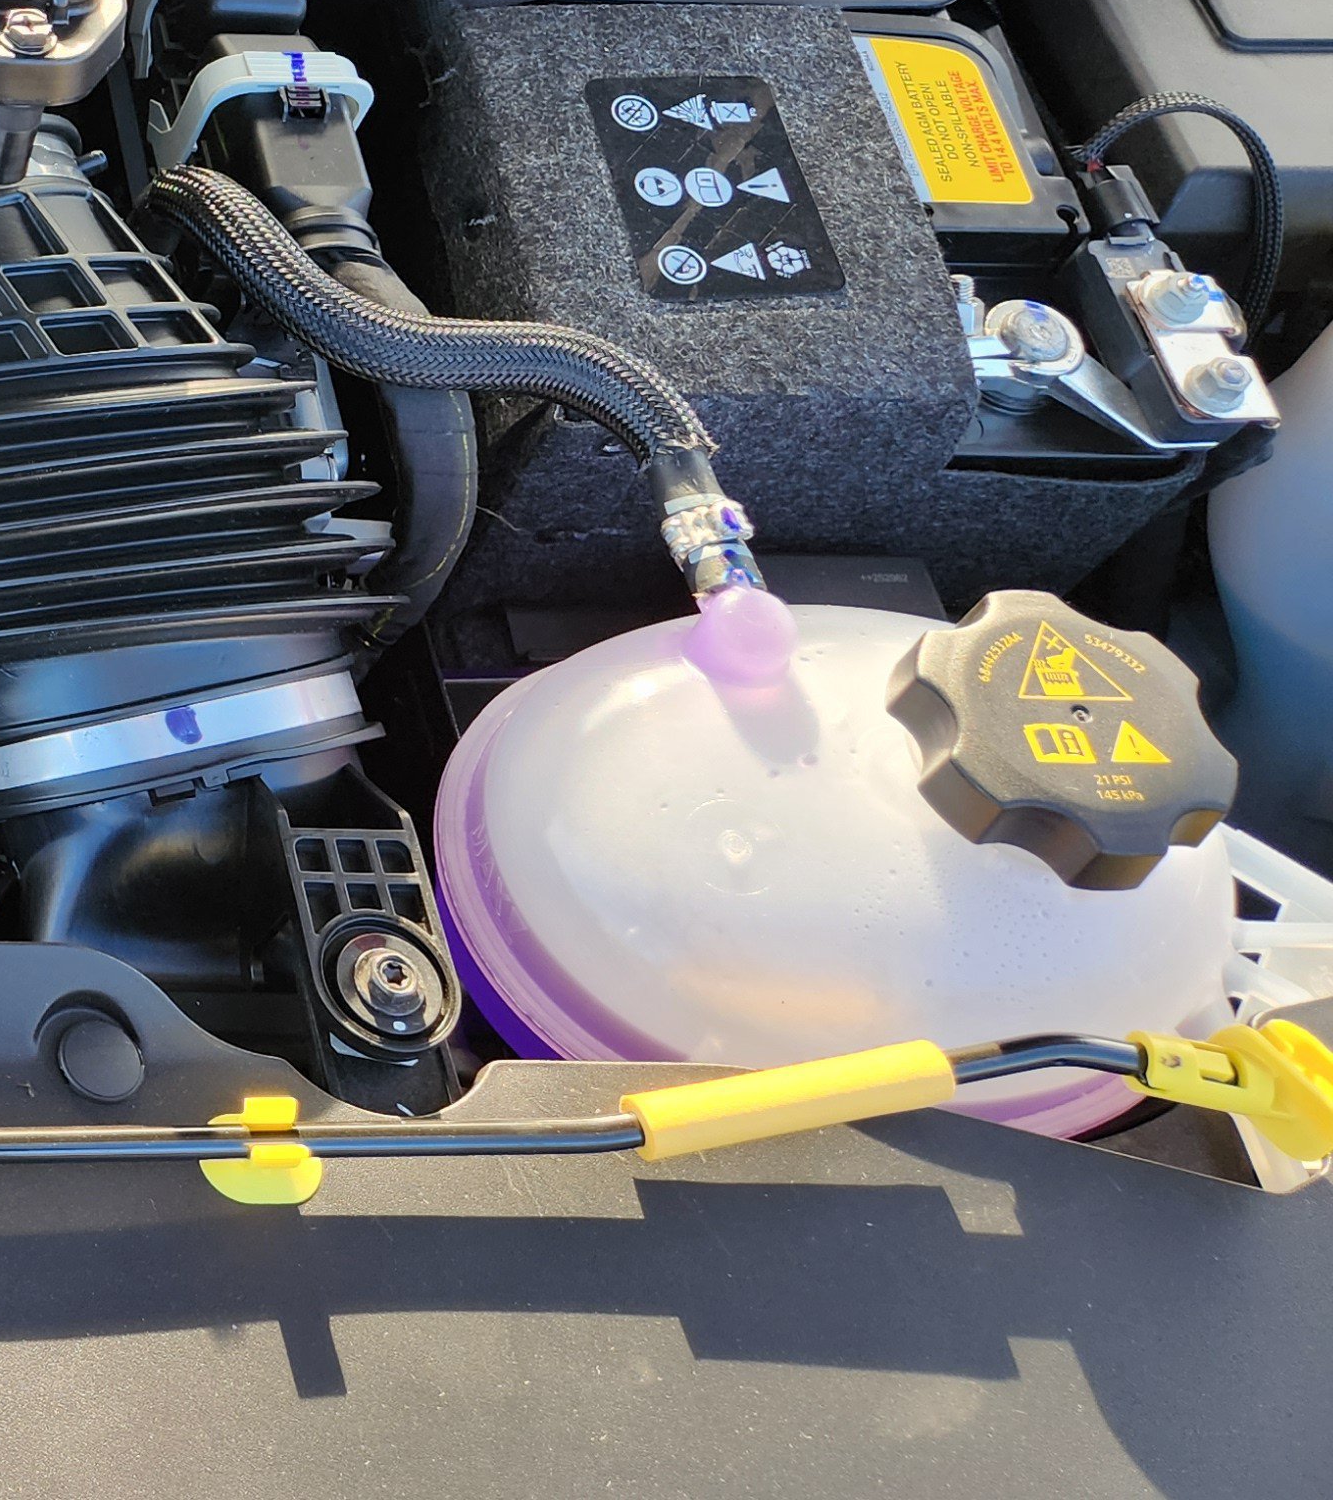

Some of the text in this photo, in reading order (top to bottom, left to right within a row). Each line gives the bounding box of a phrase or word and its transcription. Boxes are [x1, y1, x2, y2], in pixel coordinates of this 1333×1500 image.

[894, 60, 923, 108] BATTERY
[914, 111, 934, 135] AGM
[917, 82, 959, 159] DO NOT OPEN!
[935, 80, 980, 166] NON-SPILLABLE
[947, 70, 1004, 182] LIMIT CHARGE VOLTAGE
[976, 106, 998, 135] VOLTS
[925, 138, 953, 181] SEALED
[990, 138, 1008, 157] 14.4
[999, 162, 1015, 174] TO
[1093, 775, 1132, 785] 21 PSI
[1096, 790, 1144, 800] 145 kPa
